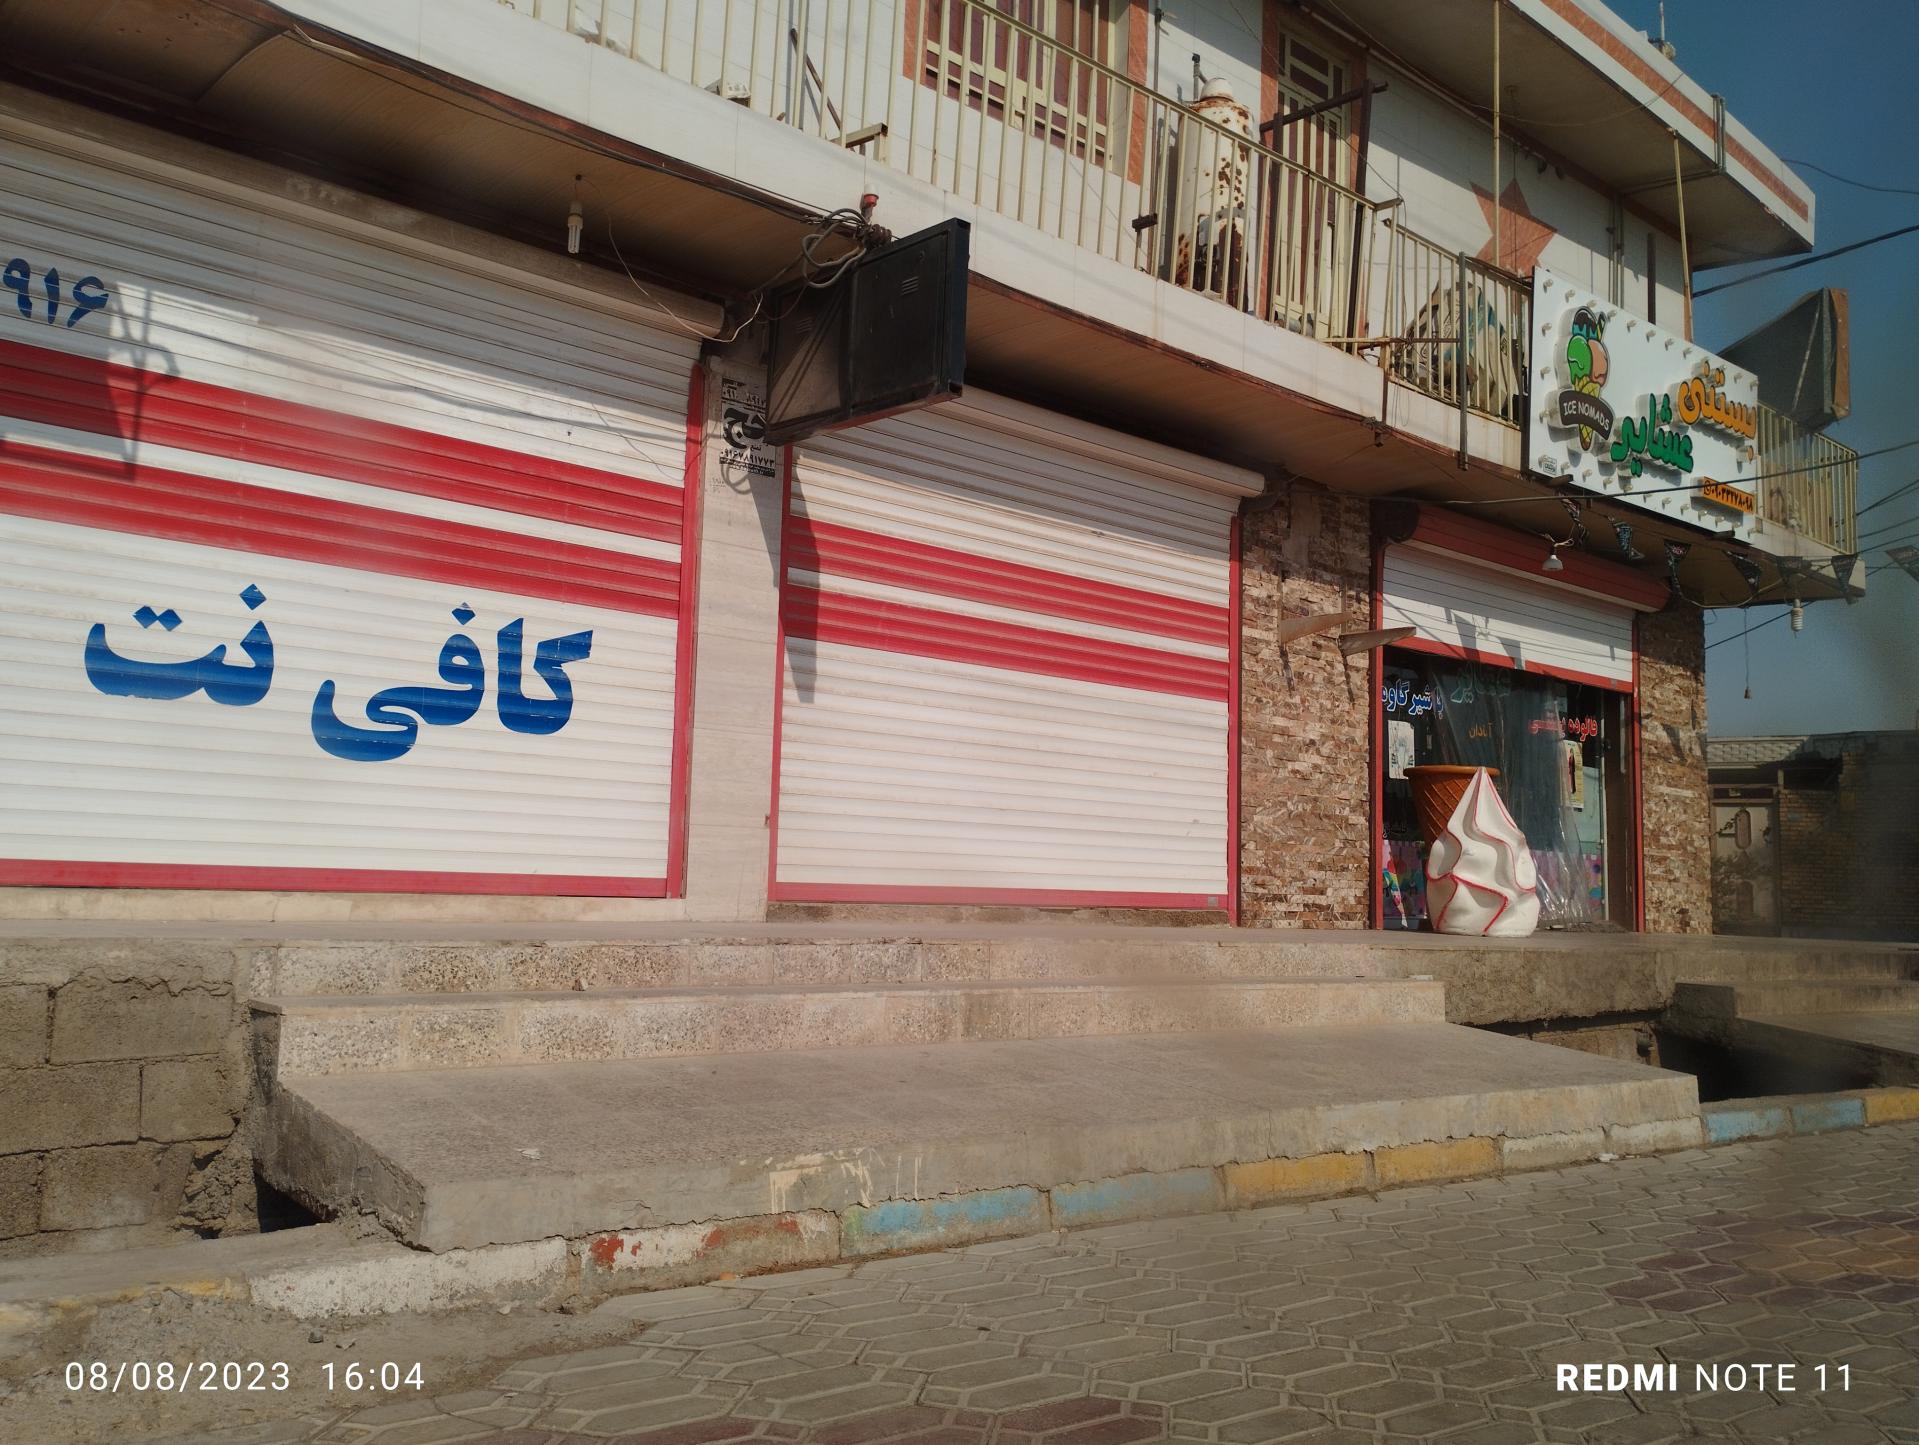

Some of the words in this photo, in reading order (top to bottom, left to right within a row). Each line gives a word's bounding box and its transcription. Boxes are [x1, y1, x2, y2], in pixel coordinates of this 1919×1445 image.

[1563, 400, 1577, 416] ICE
[1577, 401, 1610, 431] NOMADS
[1610, 393, 1694, 478] عشایر
[1678, 359, 1757, 464] بستنی
[84, 583, 275, 706] نت
[311, 602, 594, 762] کافی
[1408, 683, 1433, 715] شیر
